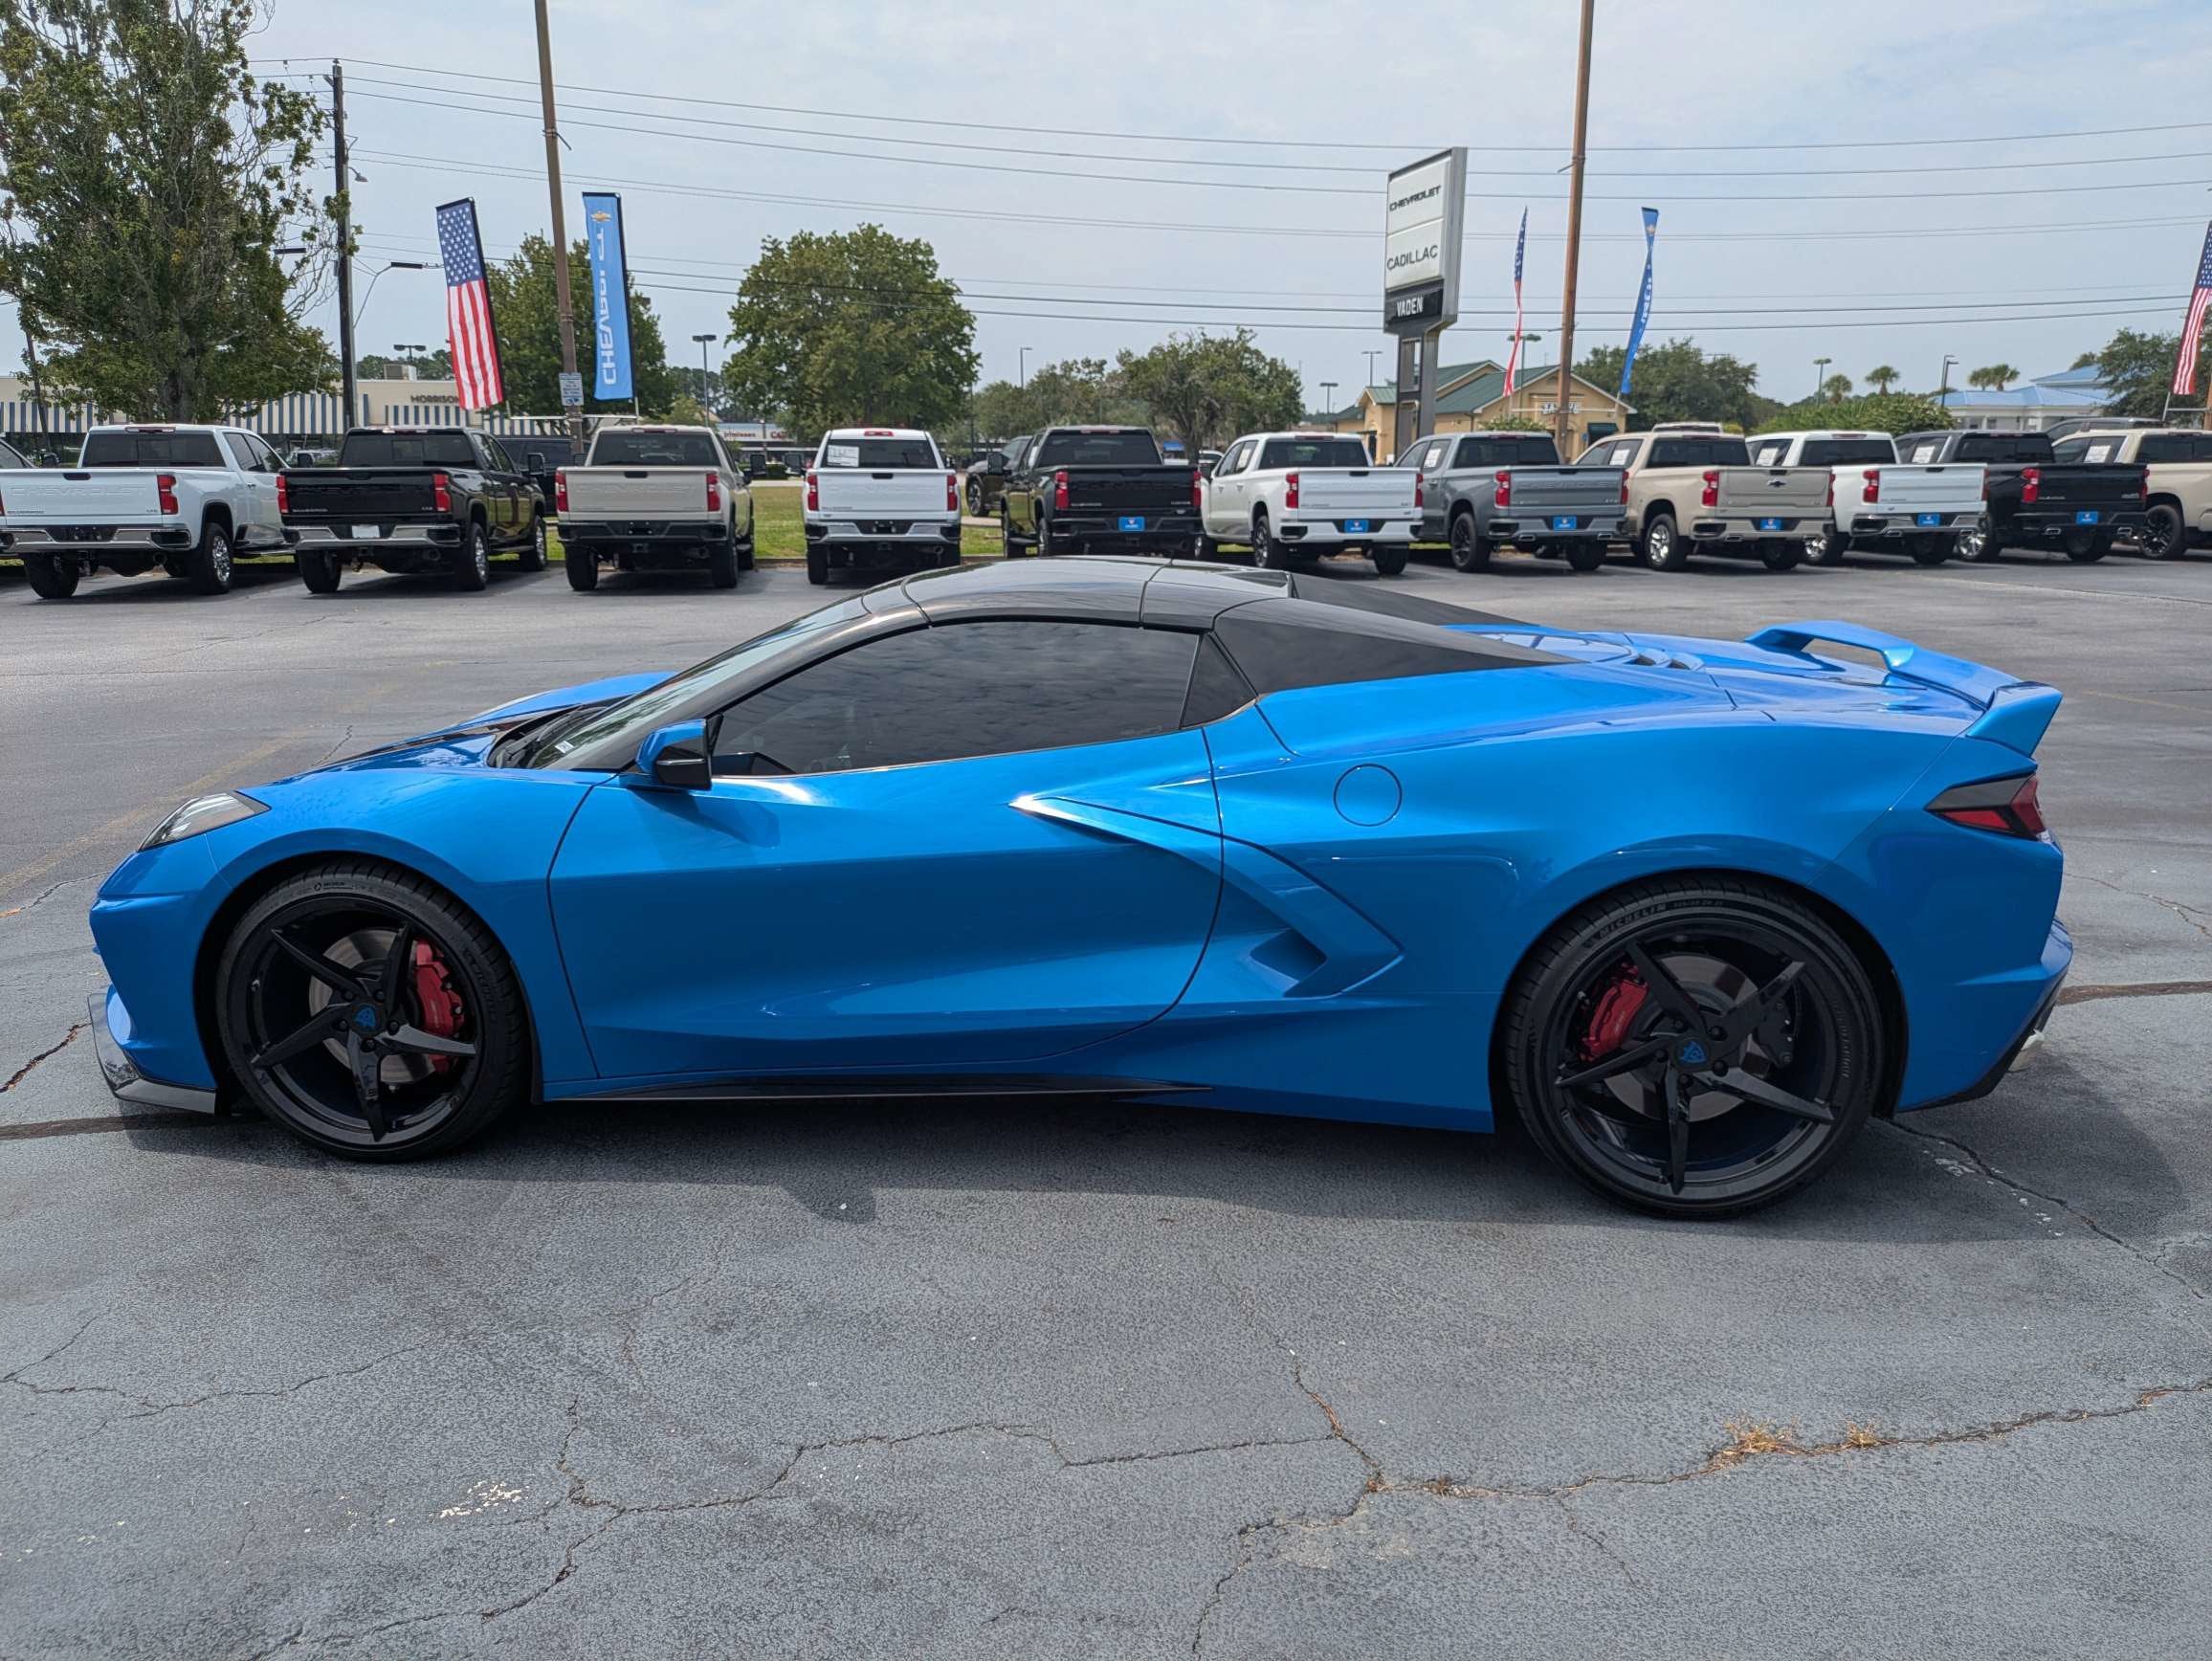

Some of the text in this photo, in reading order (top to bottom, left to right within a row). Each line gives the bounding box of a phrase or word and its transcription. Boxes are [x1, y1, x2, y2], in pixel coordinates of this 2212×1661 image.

[1389, 185, 1442, 211] CHEVROLET
[1386, 244, 1439, 271] CADILLAC
[1397, 297, 1424, 317] VADEN
